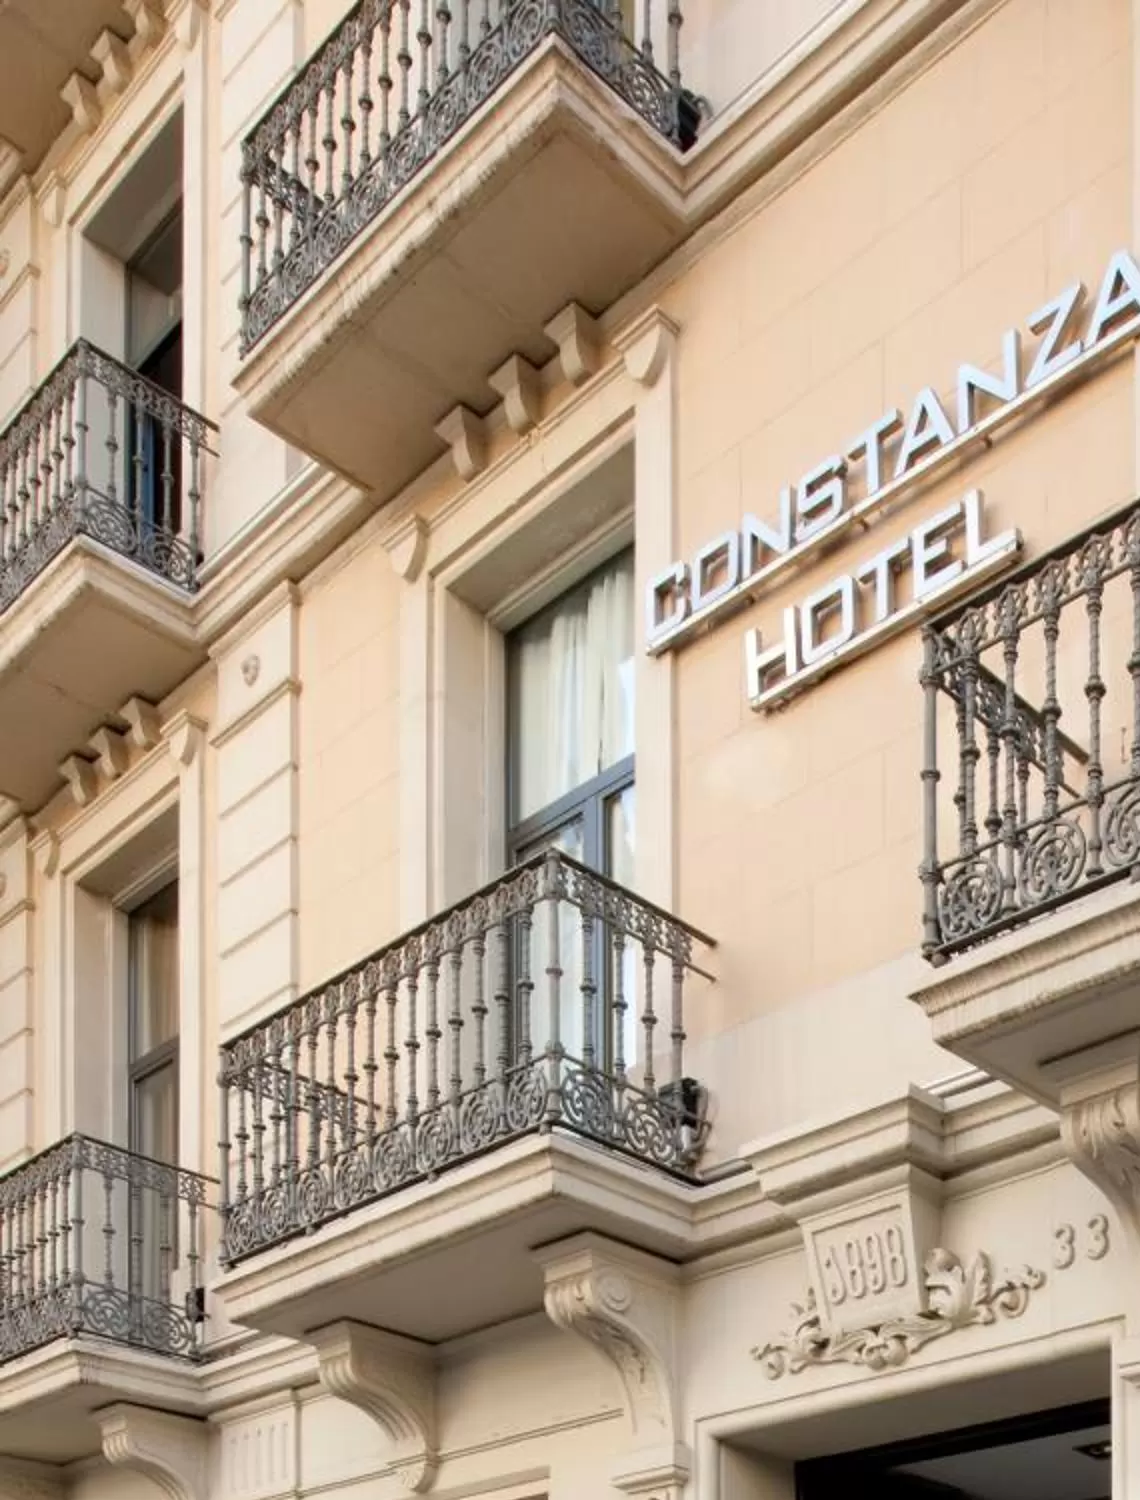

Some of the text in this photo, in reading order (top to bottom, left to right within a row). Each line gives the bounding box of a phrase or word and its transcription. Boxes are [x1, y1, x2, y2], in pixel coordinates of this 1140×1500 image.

[746, 489, 1021, 704] HOTEL
[824, 1224, 909, 1306] 1898
[1053, 1213, 1110, 1271] 33
